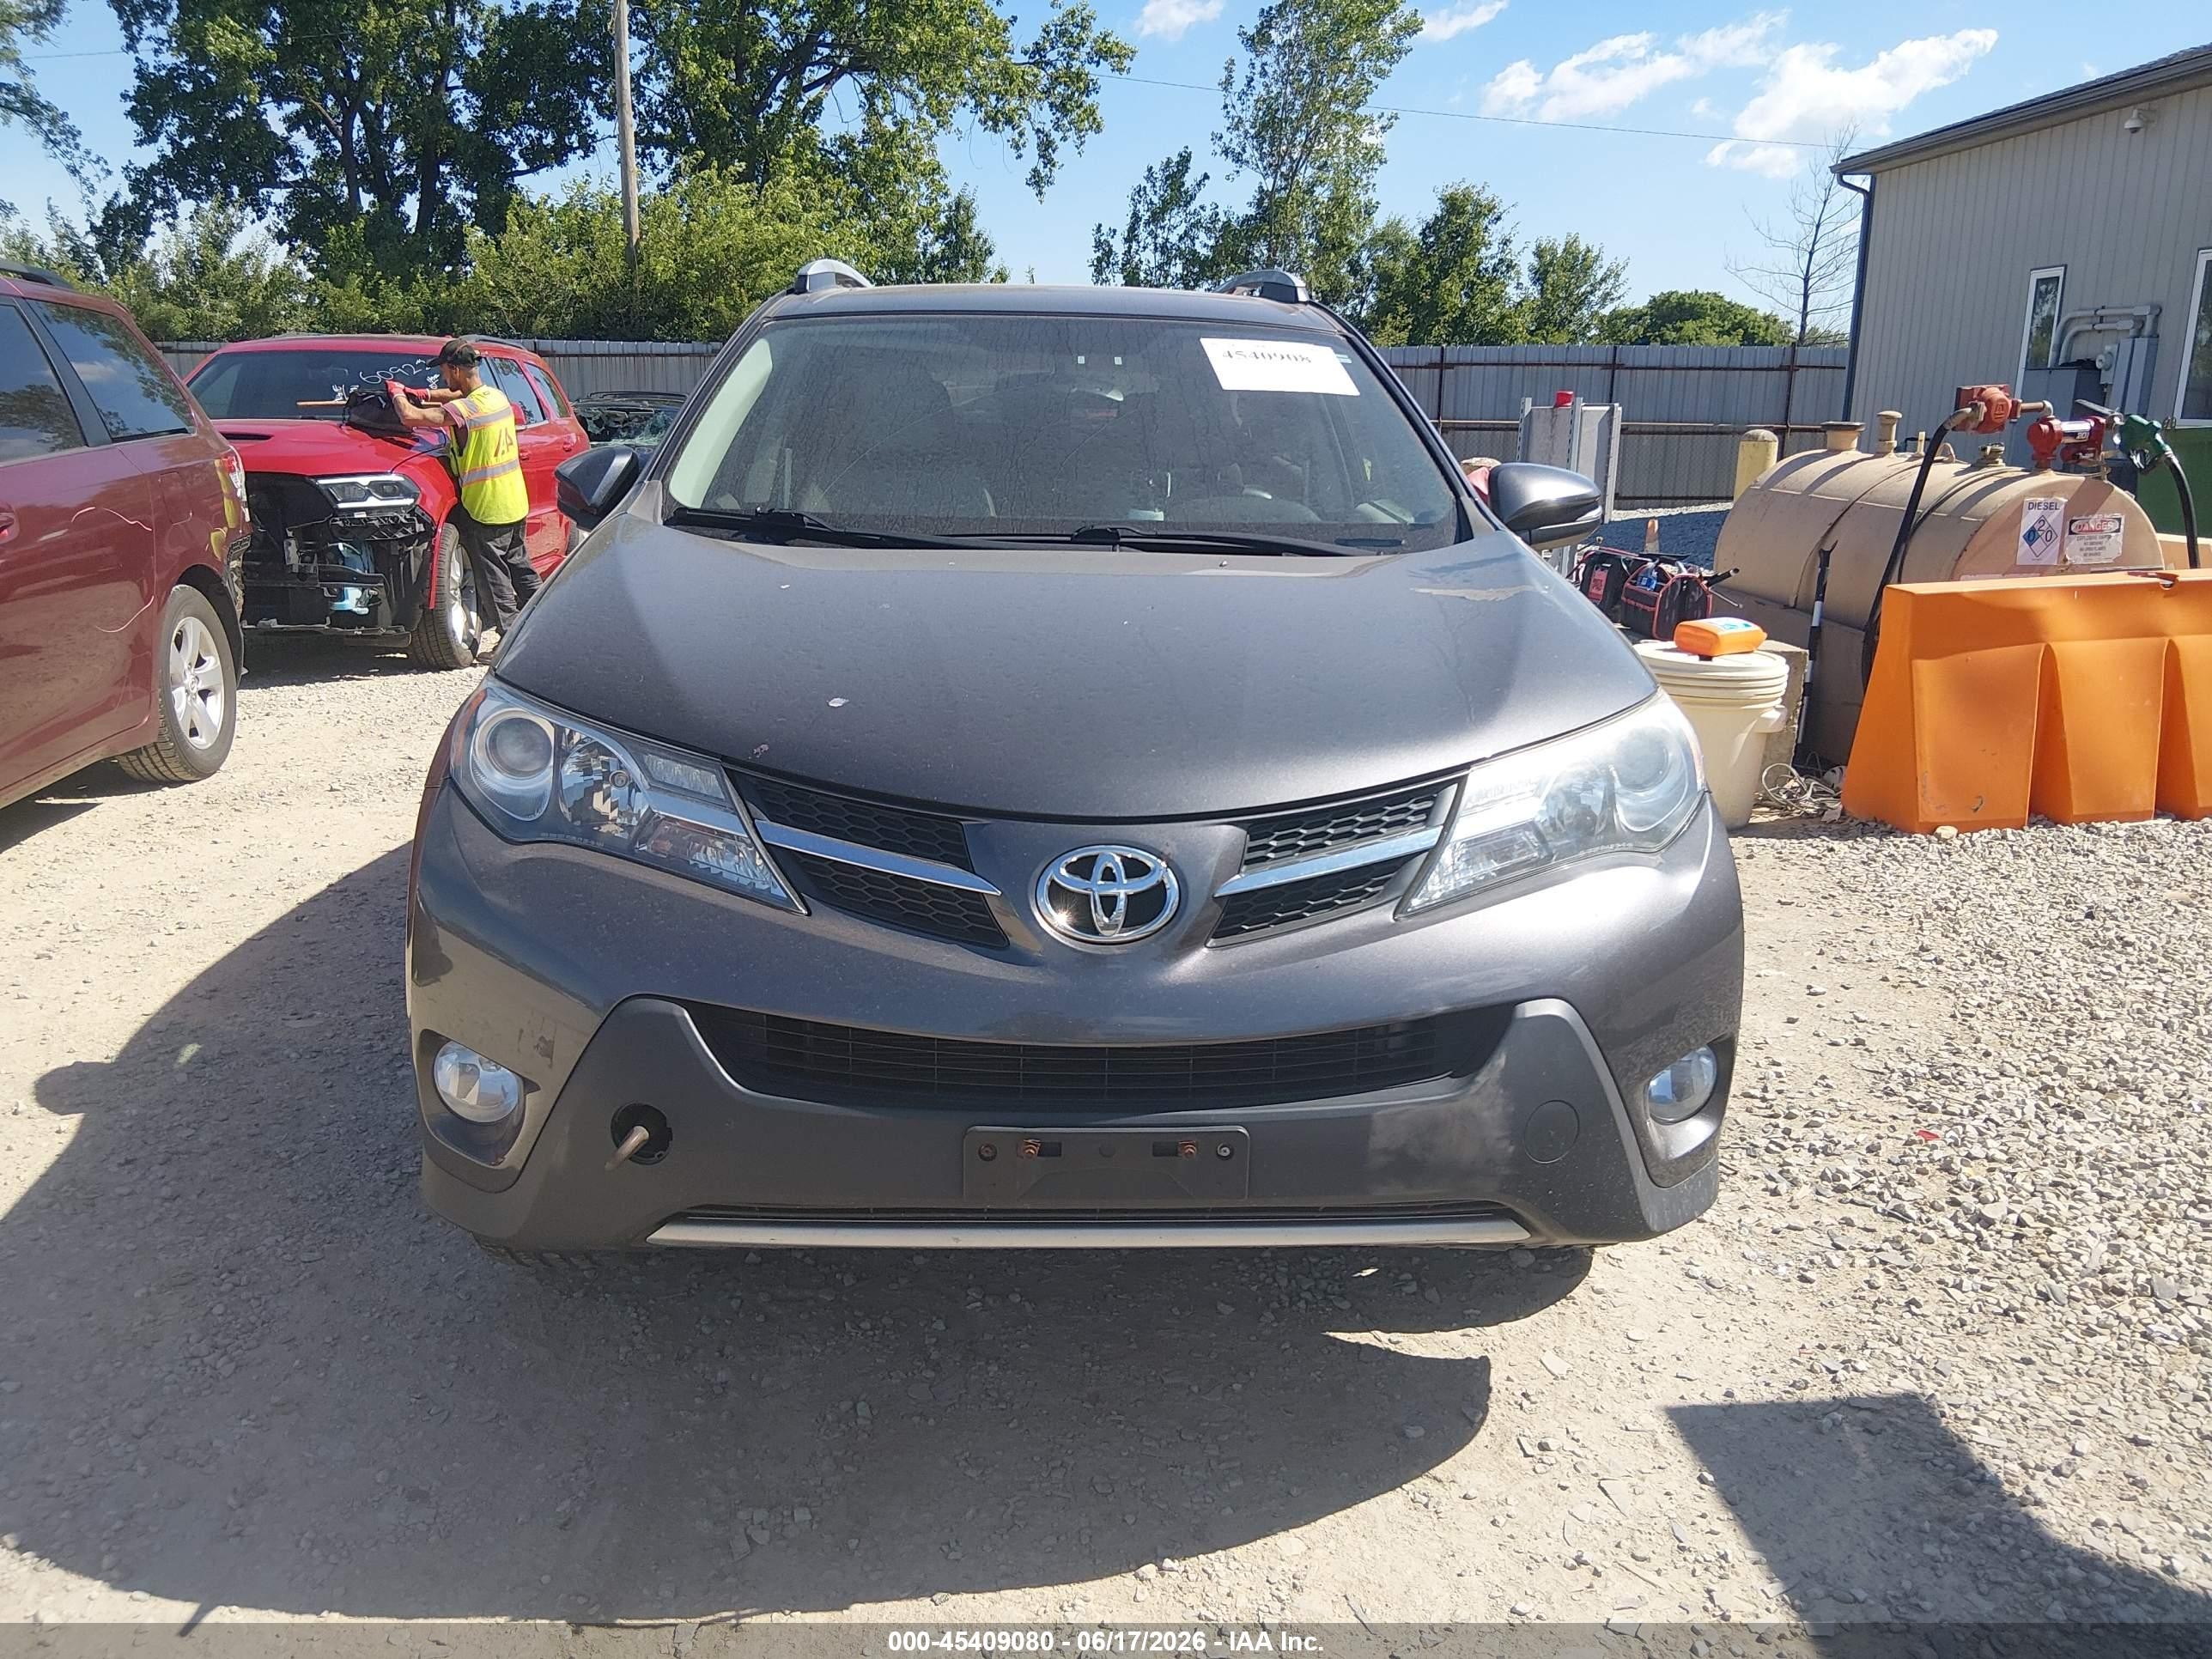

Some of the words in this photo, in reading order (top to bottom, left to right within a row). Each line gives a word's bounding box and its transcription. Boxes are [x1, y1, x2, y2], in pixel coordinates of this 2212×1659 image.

[2027, 501, 2060, 511] DIESEL
[2037, 519, 2046, 532] 2
[2027, 529, 2036, 542] 0
[2045, 530, 2053, 542] 0
